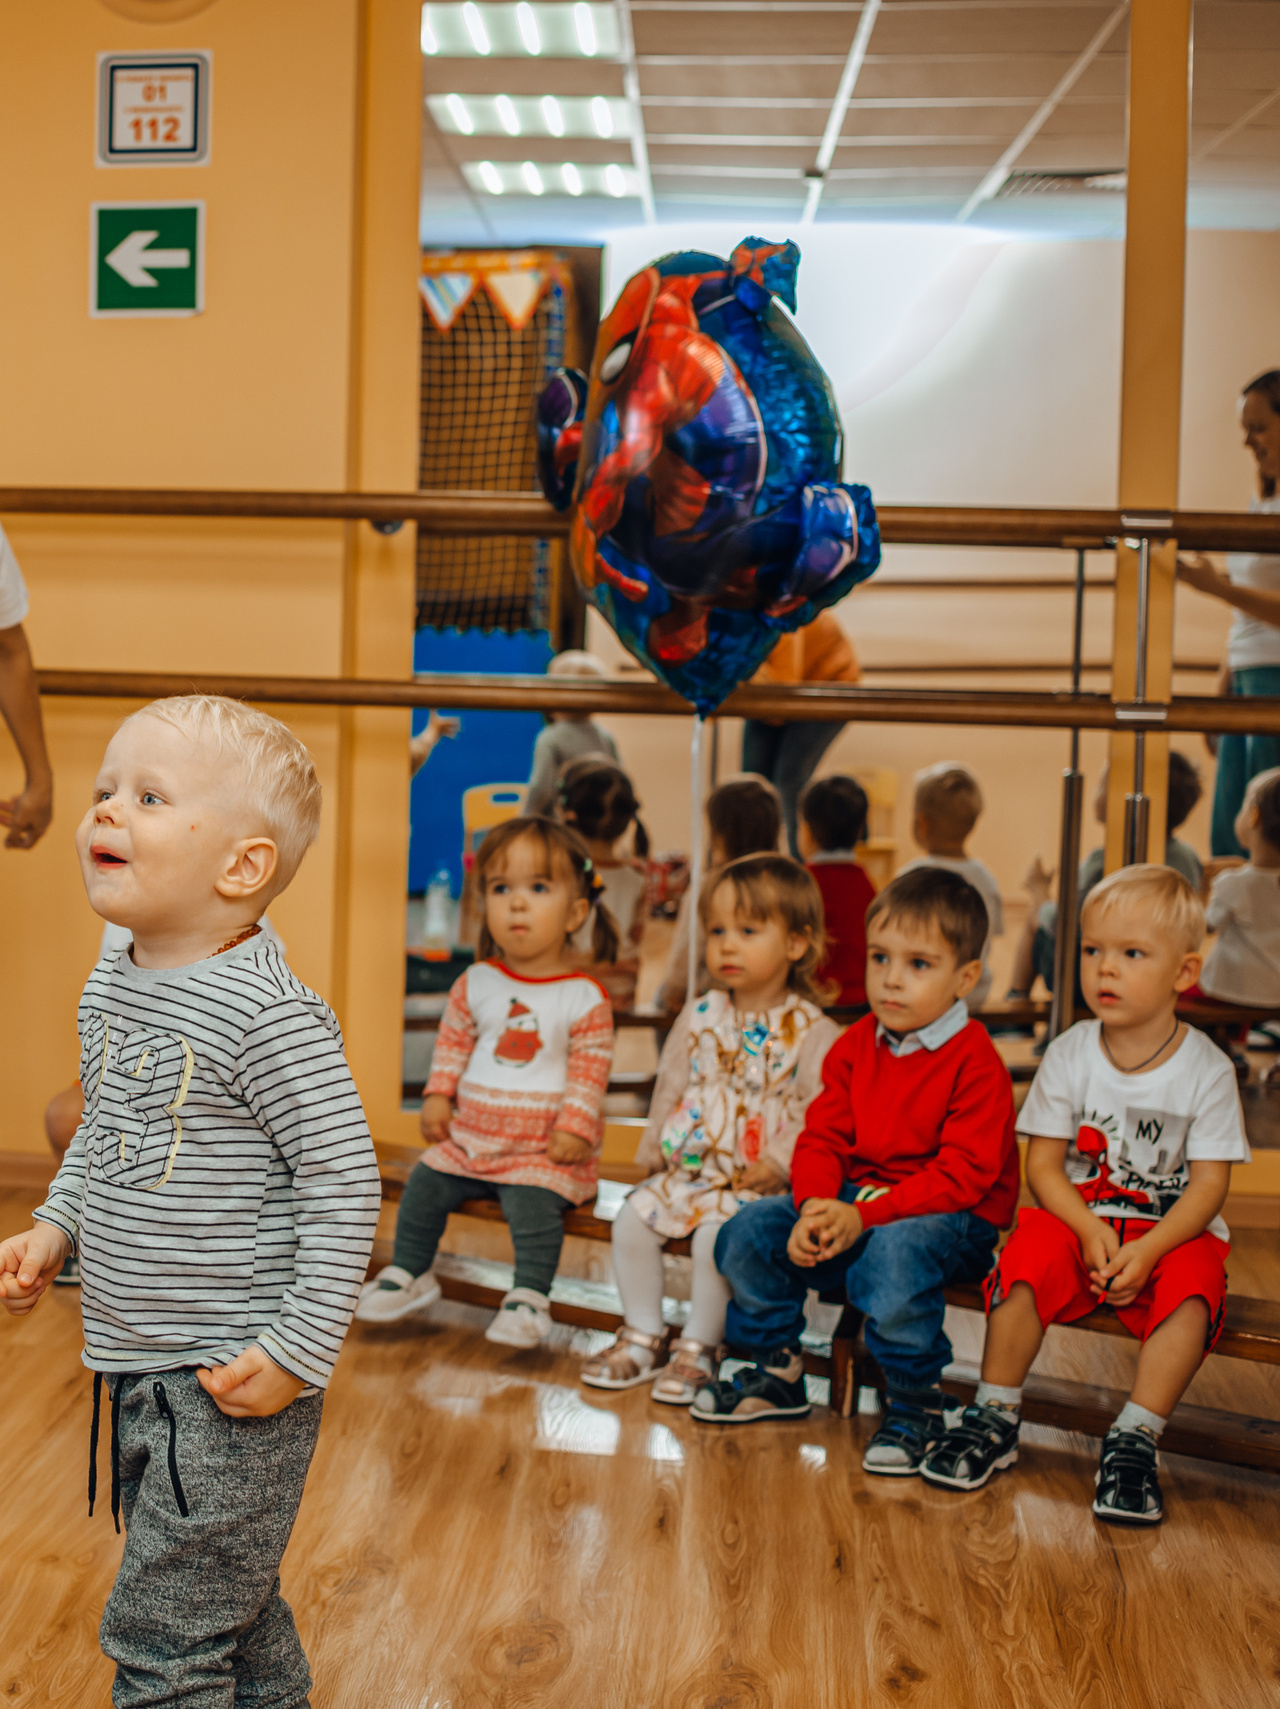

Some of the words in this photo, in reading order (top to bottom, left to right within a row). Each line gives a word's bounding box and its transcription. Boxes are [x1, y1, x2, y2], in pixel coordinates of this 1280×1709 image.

[141, 84, 167, 103] 01
[128, 116, 181, 142] 112
[1135, 1118, 1165, 1145] MY
